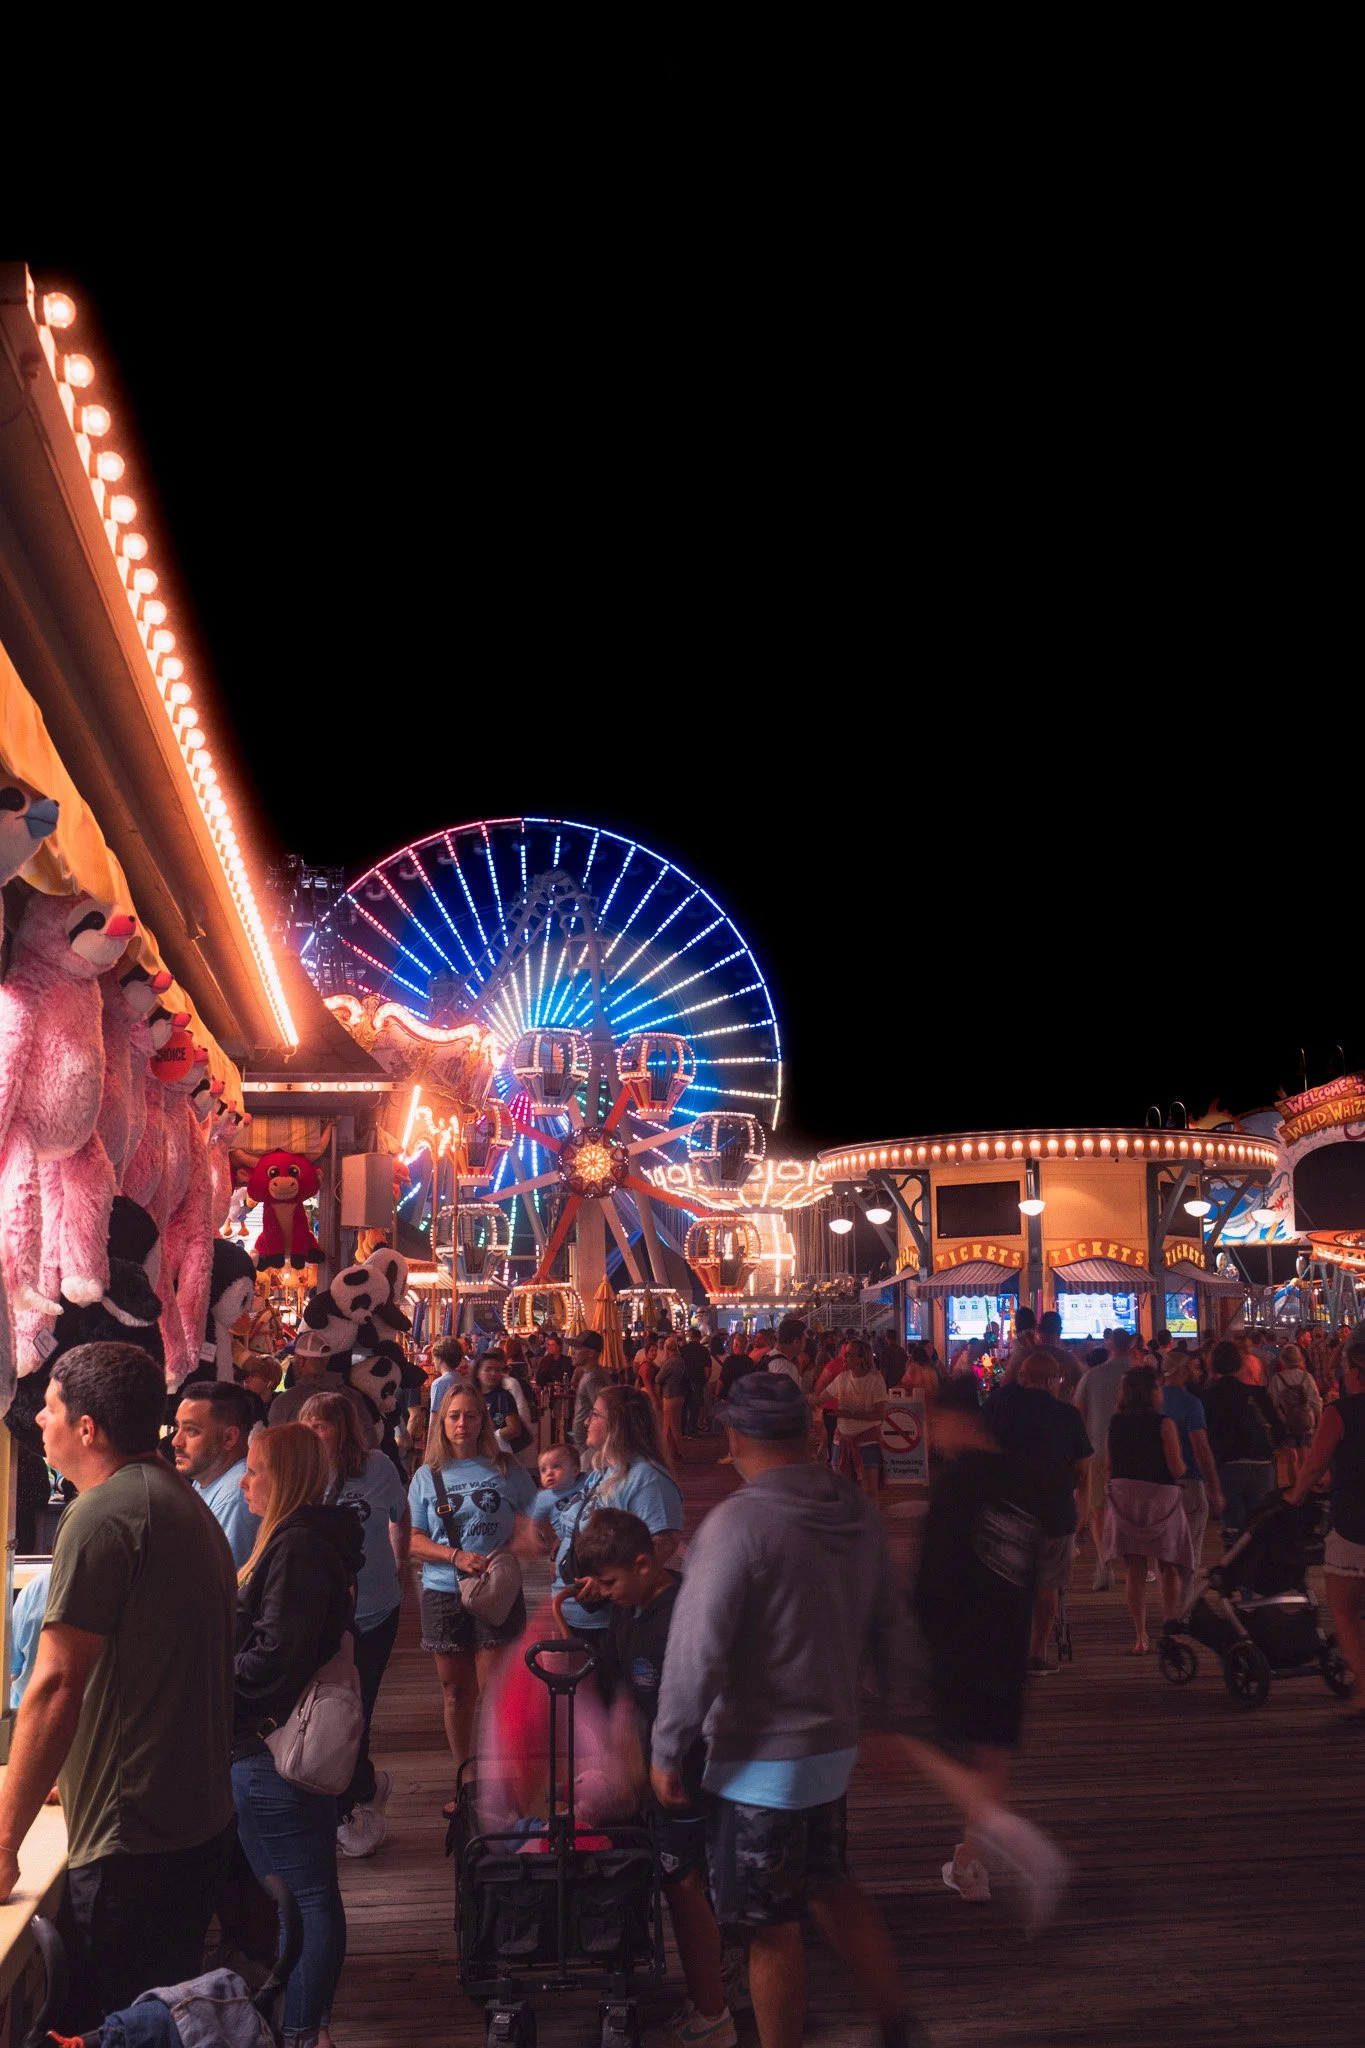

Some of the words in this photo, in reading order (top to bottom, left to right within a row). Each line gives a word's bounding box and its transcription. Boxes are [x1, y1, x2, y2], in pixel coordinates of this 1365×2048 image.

[1286, 1078, 1348, 1114] WELCOME
[936, 1243, 1021, 1267] TICKETS
[1050, 1241, 1144, 1265] TICKETS
[1165, 1243, 1206, 1268] TICKETS
[892, 1467, 919, 1475] Vaping
